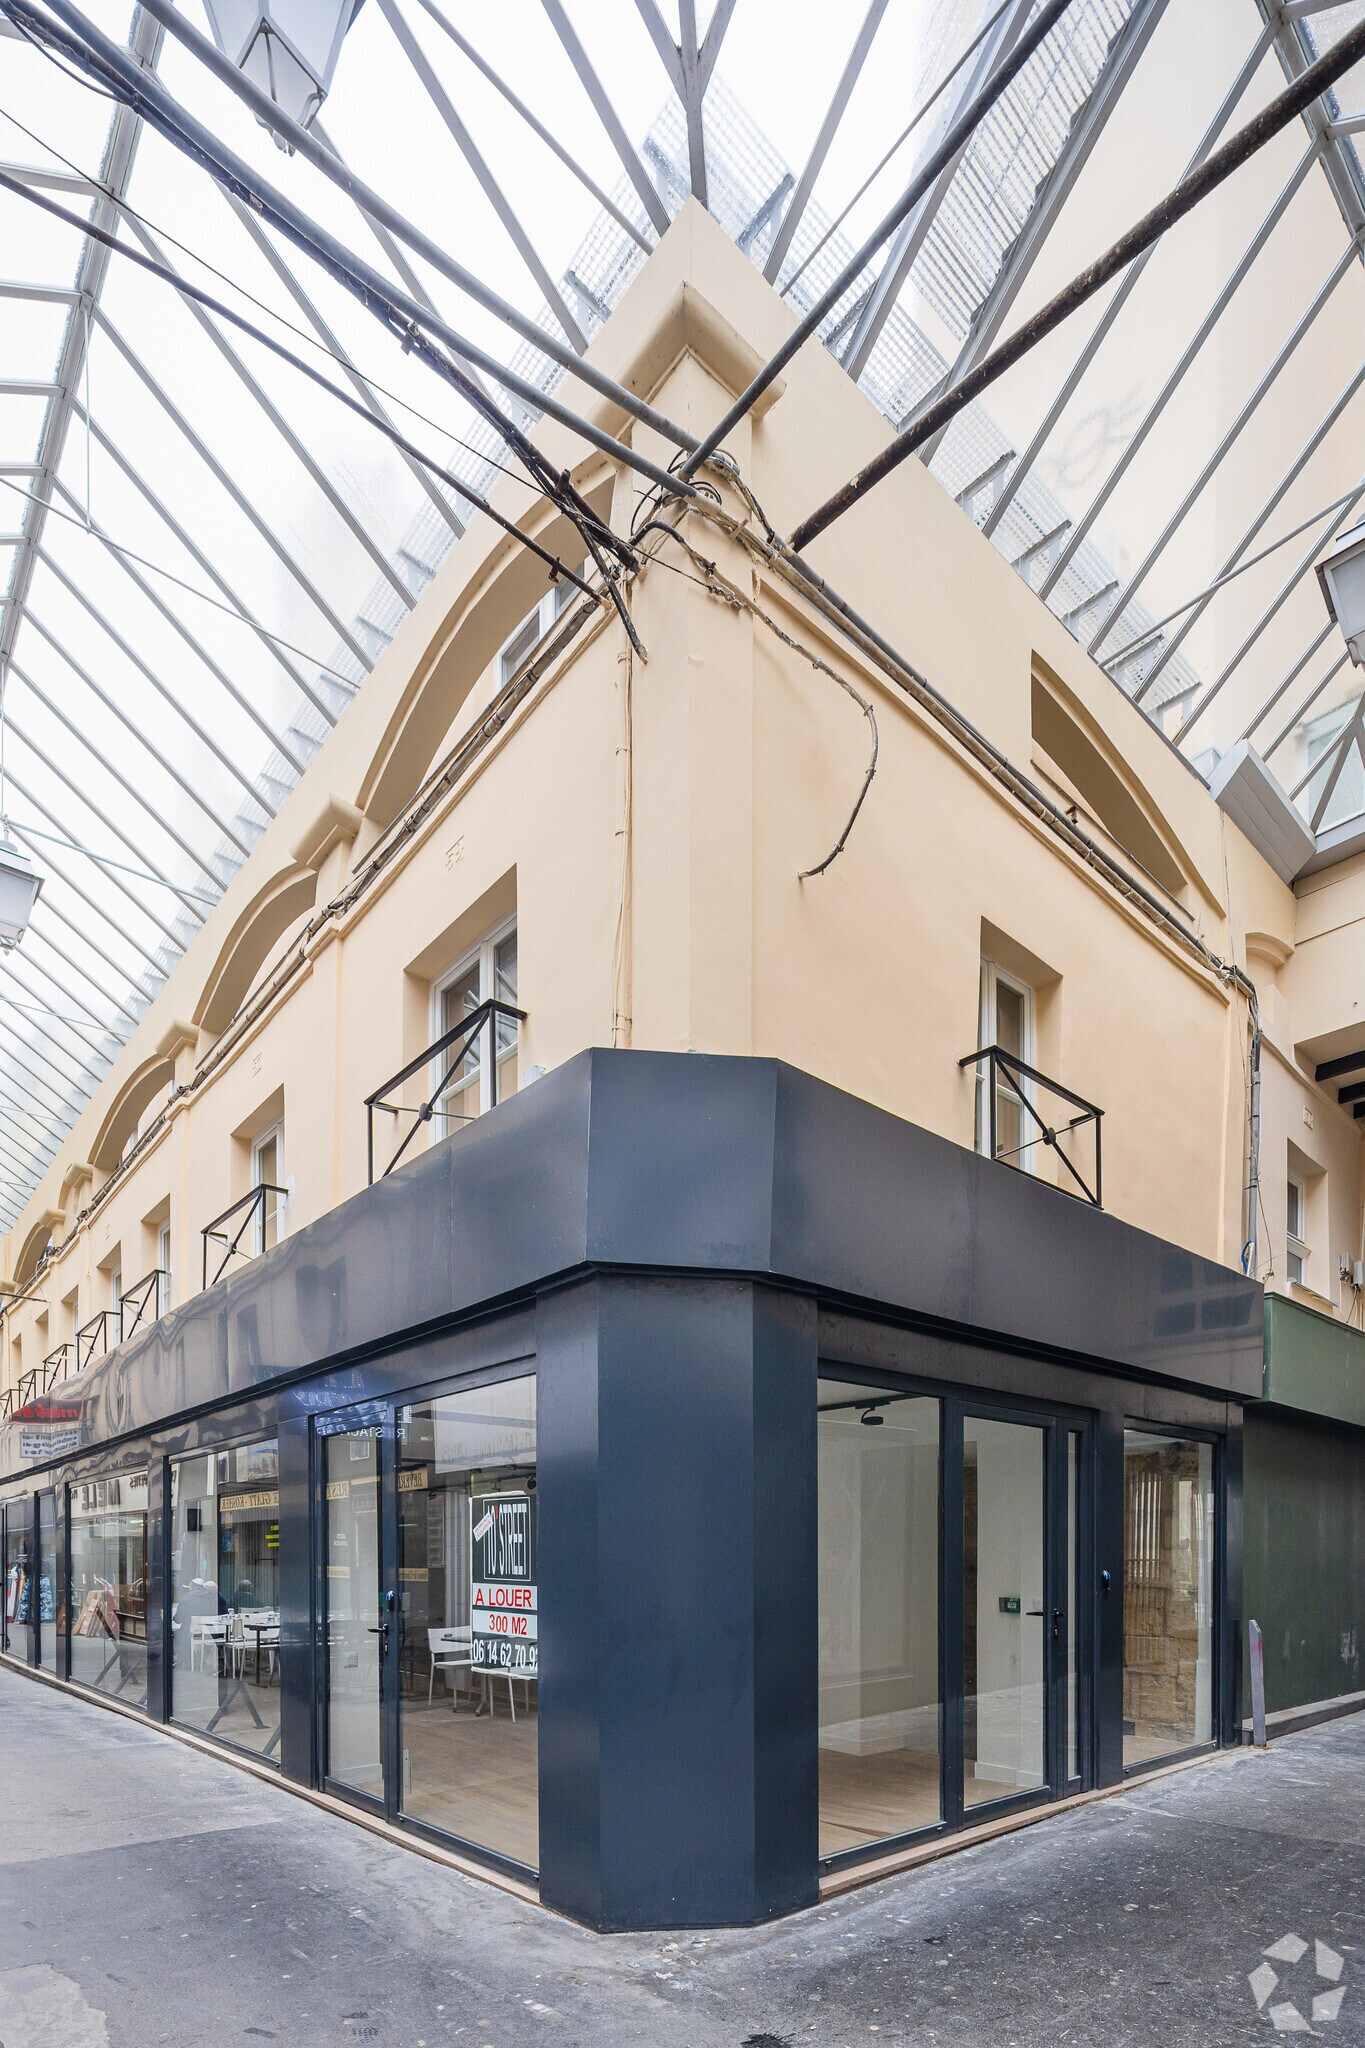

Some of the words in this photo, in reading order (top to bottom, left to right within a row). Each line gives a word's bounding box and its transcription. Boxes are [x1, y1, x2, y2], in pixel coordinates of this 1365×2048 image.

[475, 1588, 484, 1605] A
[489, 1588, 532, 1608] LOUER
[489, 1614, 508, 1633] 300
[511, 1616, 527, 1635] M2
[473, 1639, 484, 1662] 06
[487, 1640, 497, 1664] 14
[500, 1642, 511, 1666] 62
[515, 1644, 526, 1669] 70
